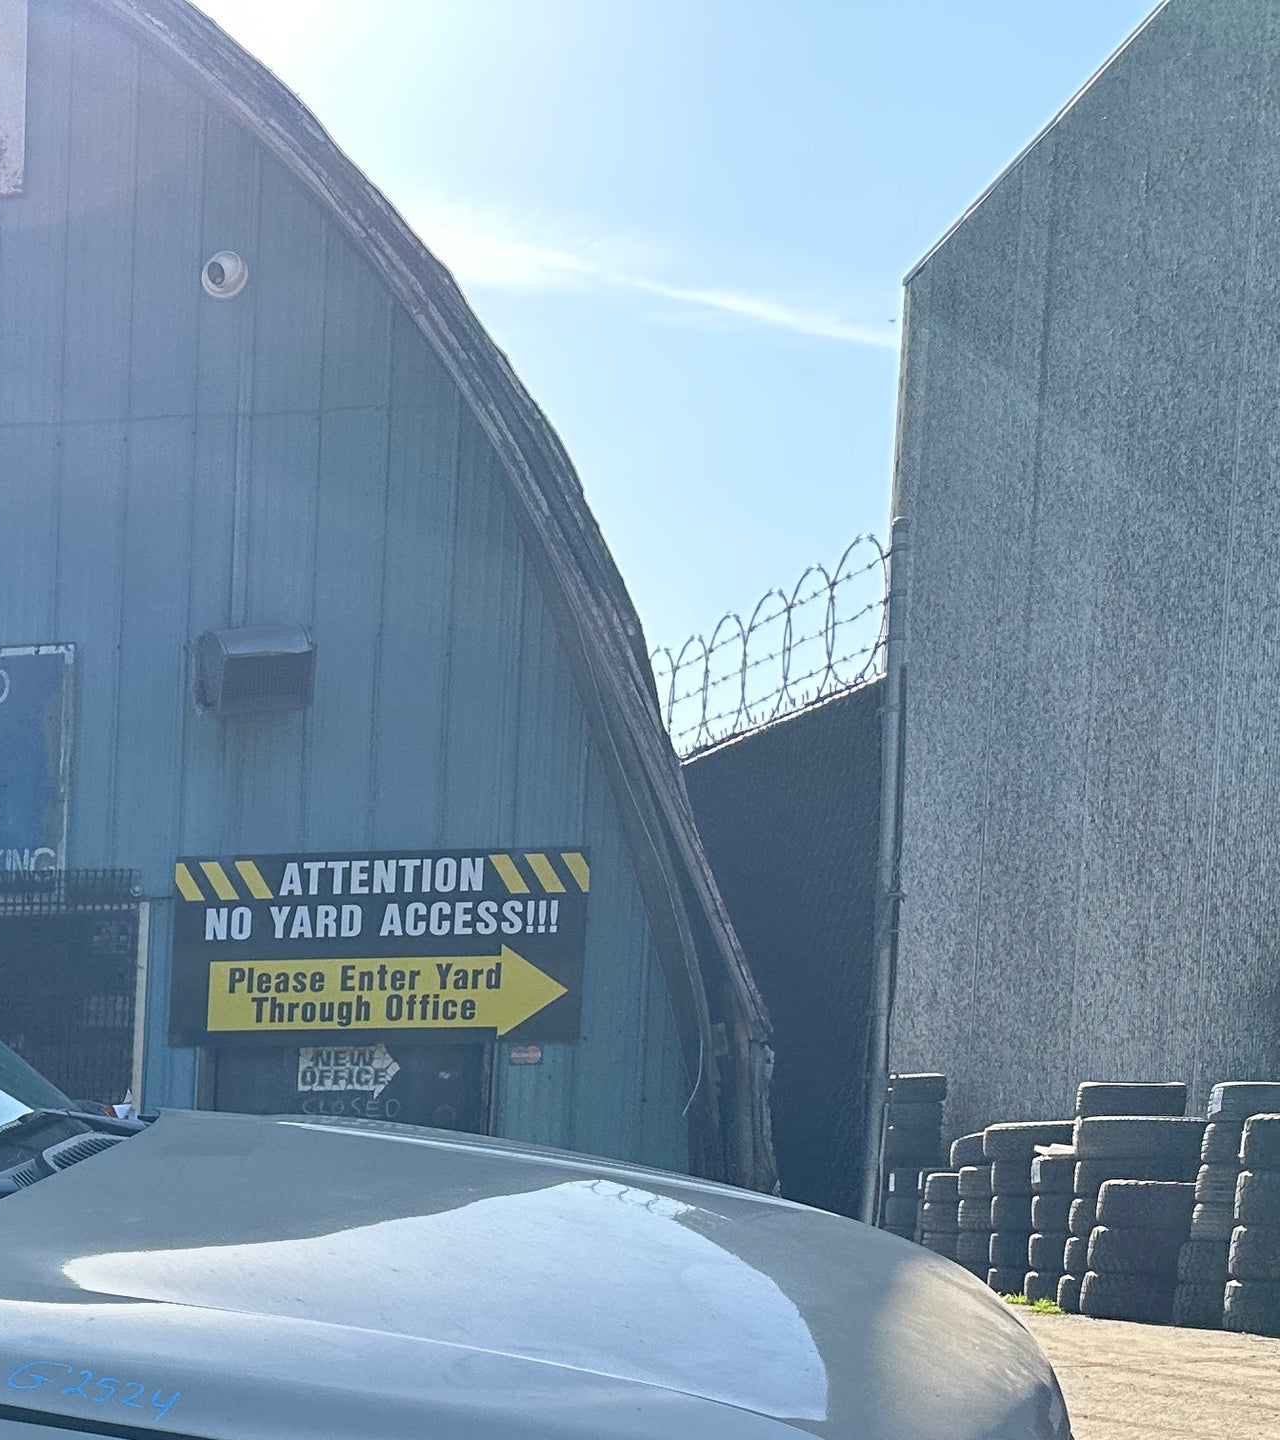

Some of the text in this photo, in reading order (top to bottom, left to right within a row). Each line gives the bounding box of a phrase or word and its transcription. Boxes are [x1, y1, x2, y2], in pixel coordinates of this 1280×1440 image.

[279, 857, 484, 896] ATTENTION
[205, 900, 559, 940] NO YARD ACCESS!!!
[228, 962, 501, 994] Please Enter Yard
[251, 993, 476, 1027] Through Office
[312, 1050, 376, 1067] NEW
[300, 1067, 389, 1087] OFFICE
[302, 1097, 401, 1117] CLOSED
[8, 1360, 182, 1421] G2524
